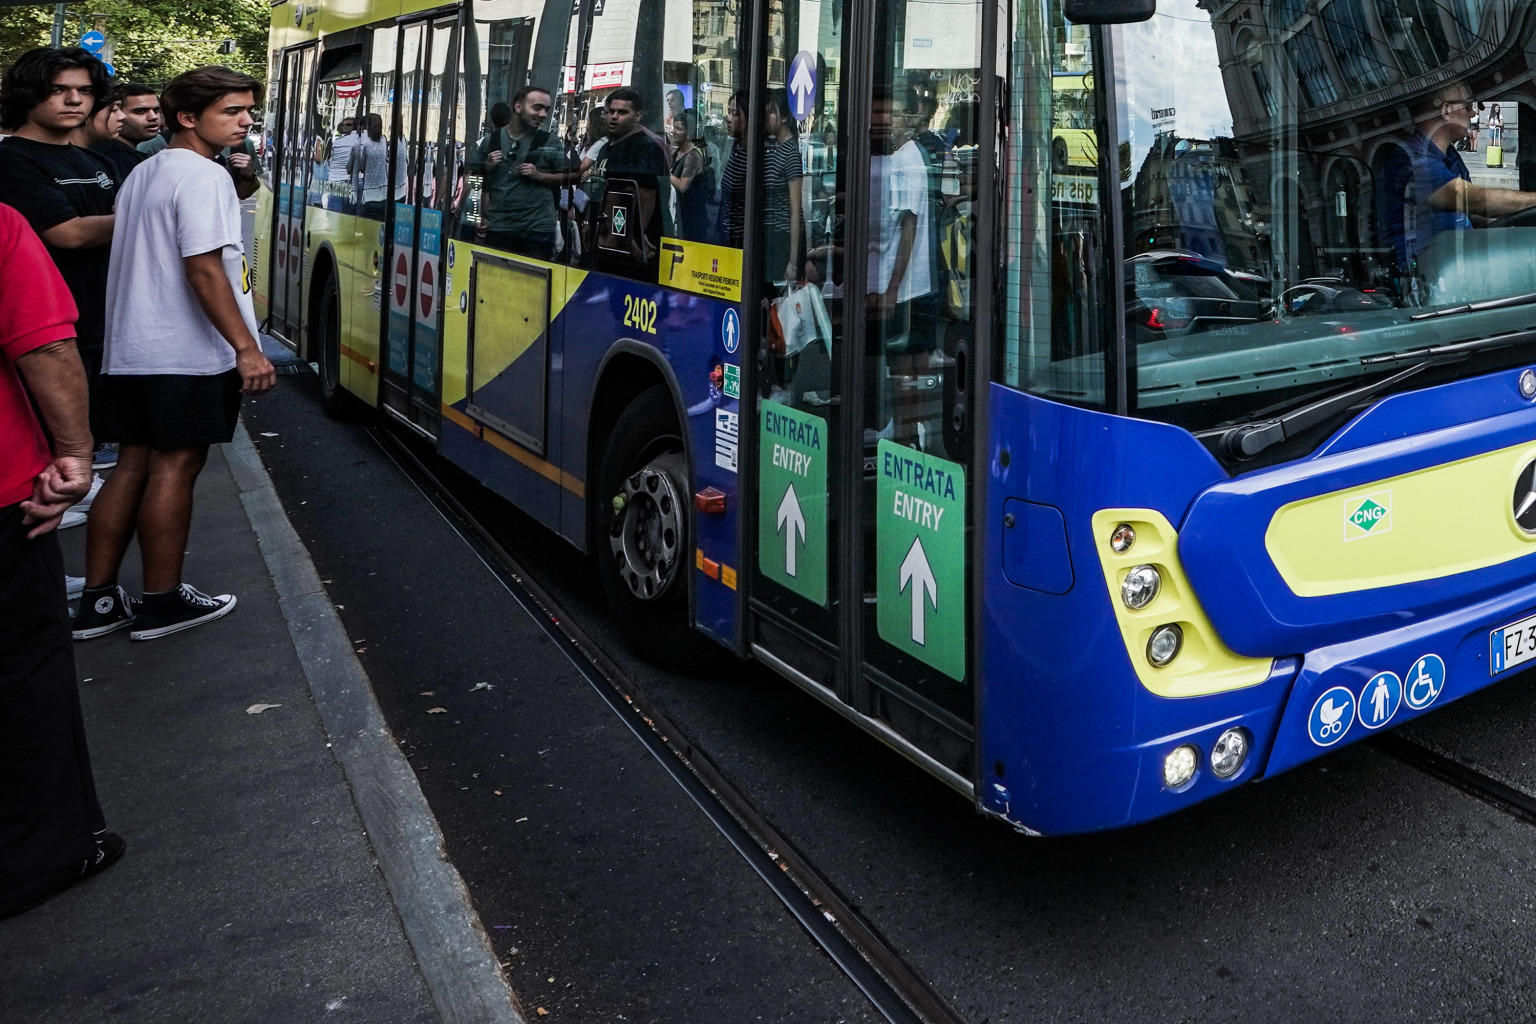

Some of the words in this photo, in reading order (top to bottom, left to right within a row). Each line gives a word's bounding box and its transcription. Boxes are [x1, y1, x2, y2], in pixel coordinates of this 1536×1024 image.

[624, 294, 657, 335] 2402
[766, 410, 821, 450] ENTRATA
[772, 444, 812, 477] ENTRY
[884, 451, 956, 501] ENTRATA
[893, 490, 945, 532] ENTRY
[1354, 506, 1382, 524] CNG
